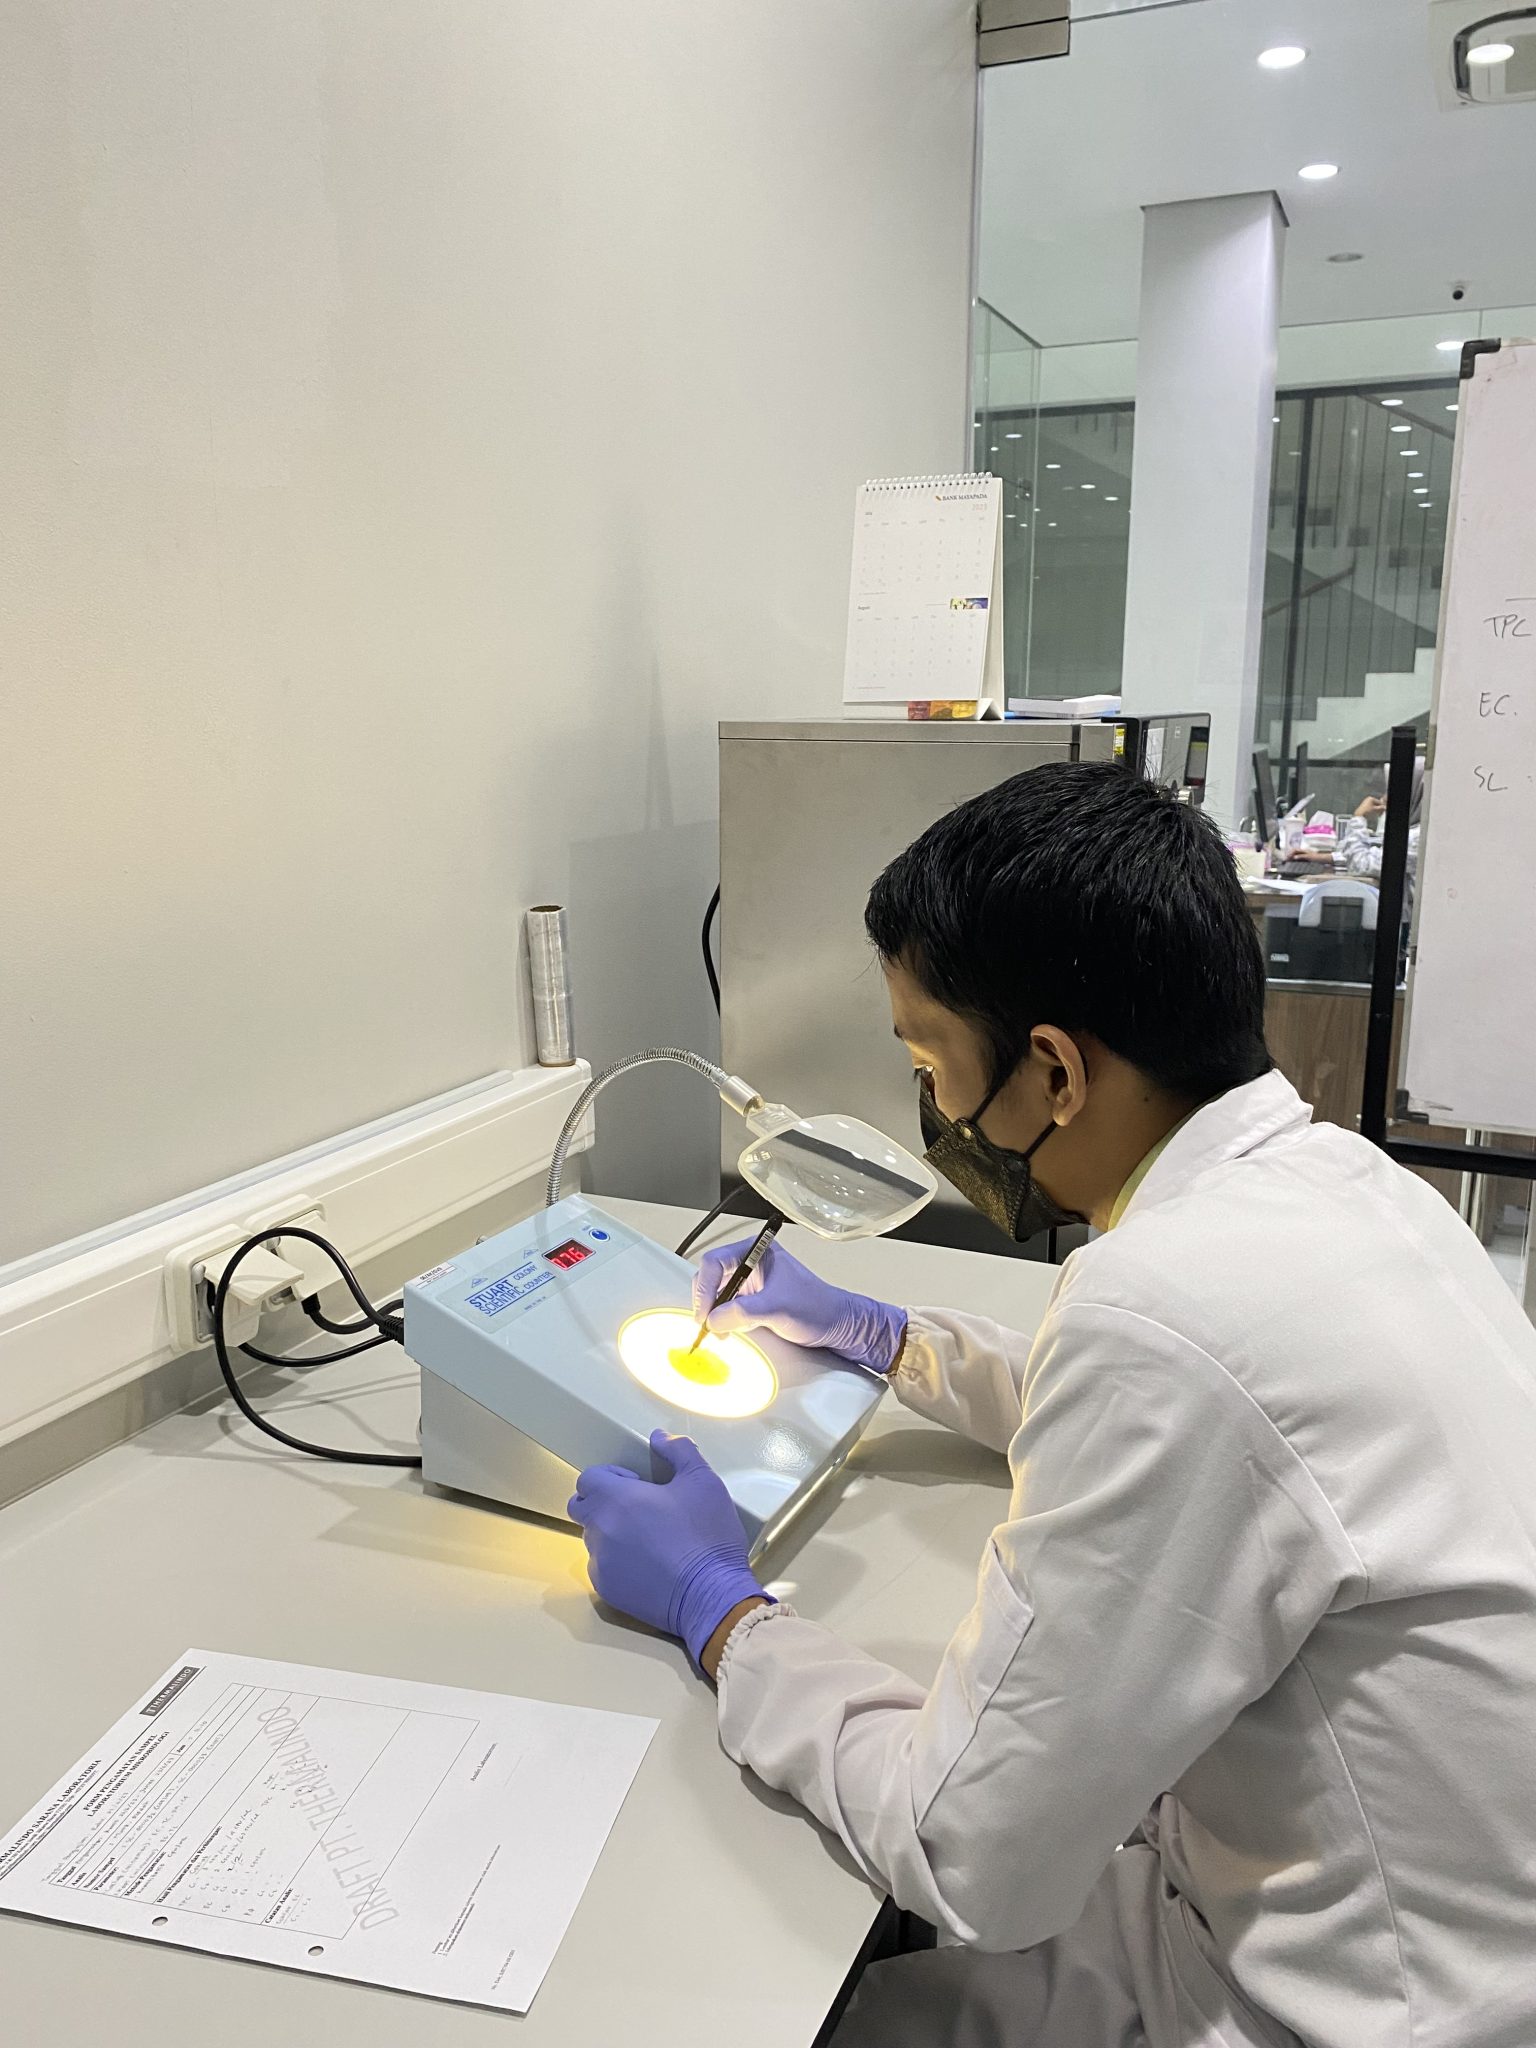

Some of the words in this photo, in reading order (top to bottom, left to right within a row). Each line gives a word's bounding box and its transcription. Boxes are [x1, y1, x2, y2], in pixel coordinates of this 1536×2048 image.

[1483, 613, 1531, 638] TPC
[1474, 765, 1508, 792] SL
[469, 1279, 514, 1308] STUART
[513, 1264, 537, 1281] COLONY
[479, 1286, 525, 1314] SCIENTIFIC
[523, 1271, 553, 1291] COUNTER
[149, 1668, 191, 1712] THERMALINDO
[29, 1802, 60, 1828] SARANA
[54, 1759, 103, 1802] LABORATORIA
[81, 1793, 103, 1810] FORM
[97, 1754, 139, 1792] PENGAMATAN
[133, 1733, 158, 1755] SAMPEL
[85, 1771, 133, 1817] LABORATORIUM
[128, 1731, 170, 1771] MIKROBIOLOGI
[257, 1706, 346, 1831] THERMALINDO
[333, 1859, 399, 1930] DRAFT
